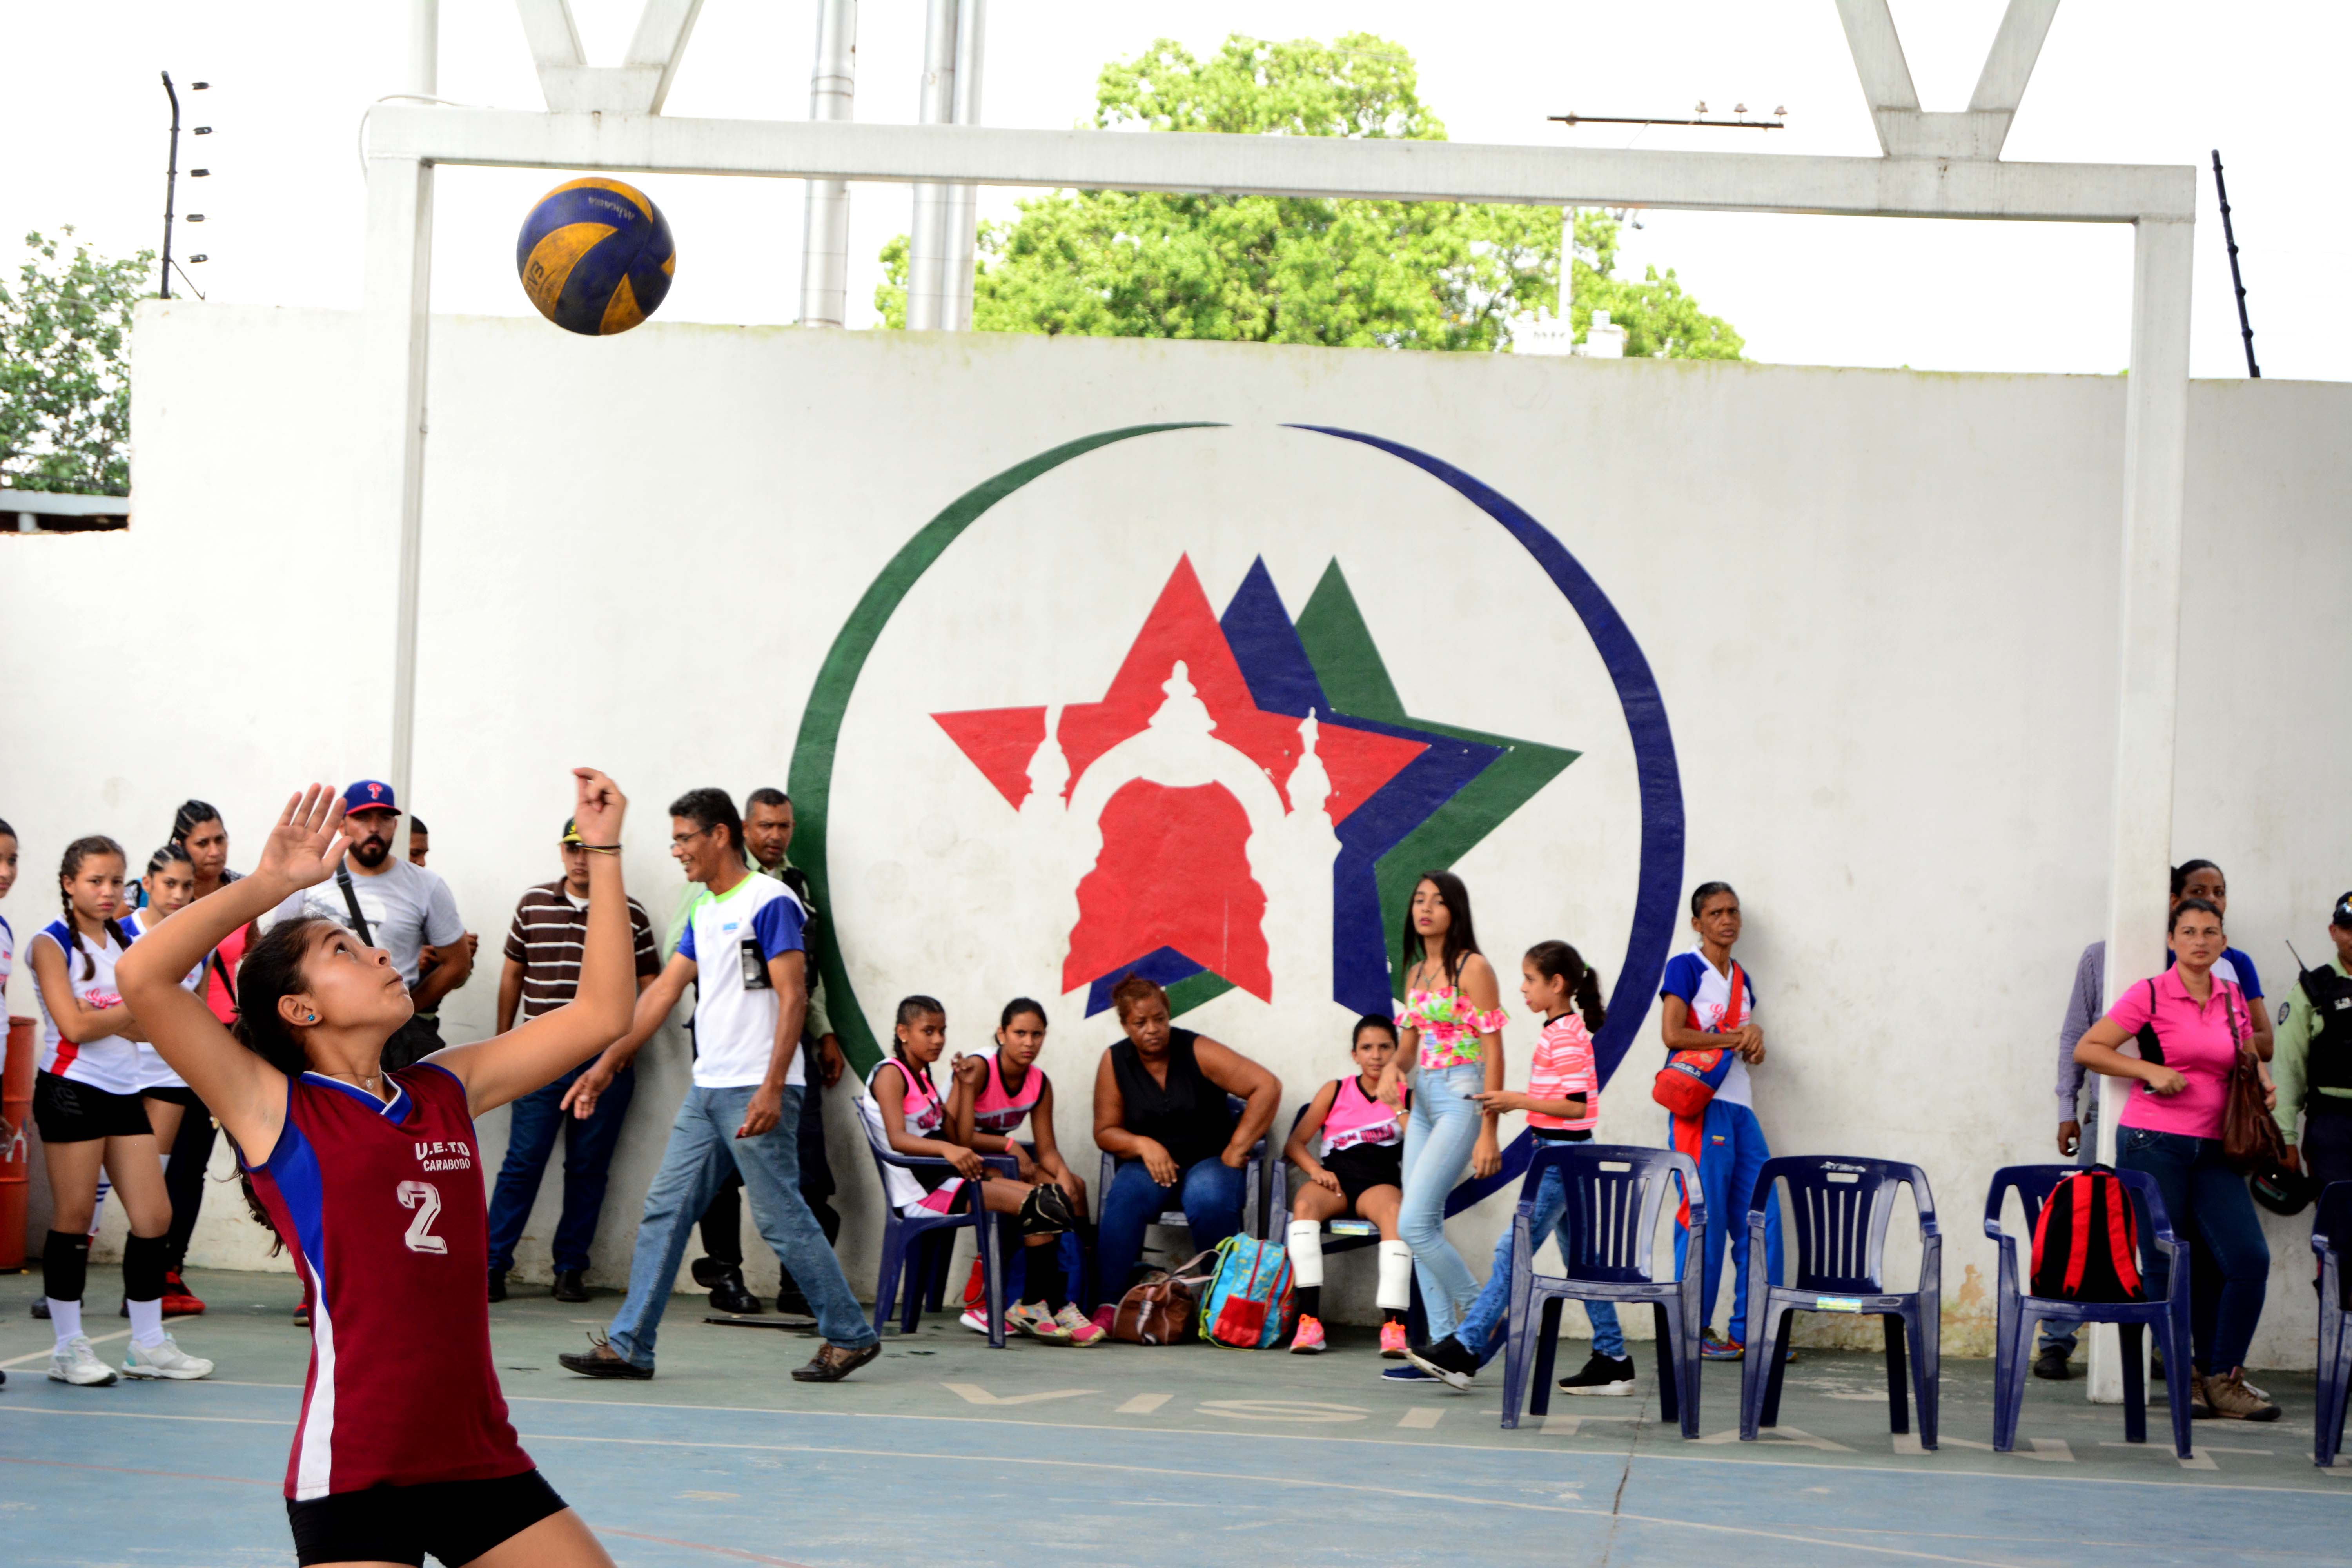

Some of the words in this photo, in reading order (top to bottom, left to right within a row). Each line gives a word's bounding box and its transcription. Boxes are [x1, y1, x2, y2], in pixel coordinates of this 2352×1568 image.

[367, 783, 383, 800] P
[423, 1158, 471, 1172] CARABOBO
[397, 1180, 448, 1254] 2
